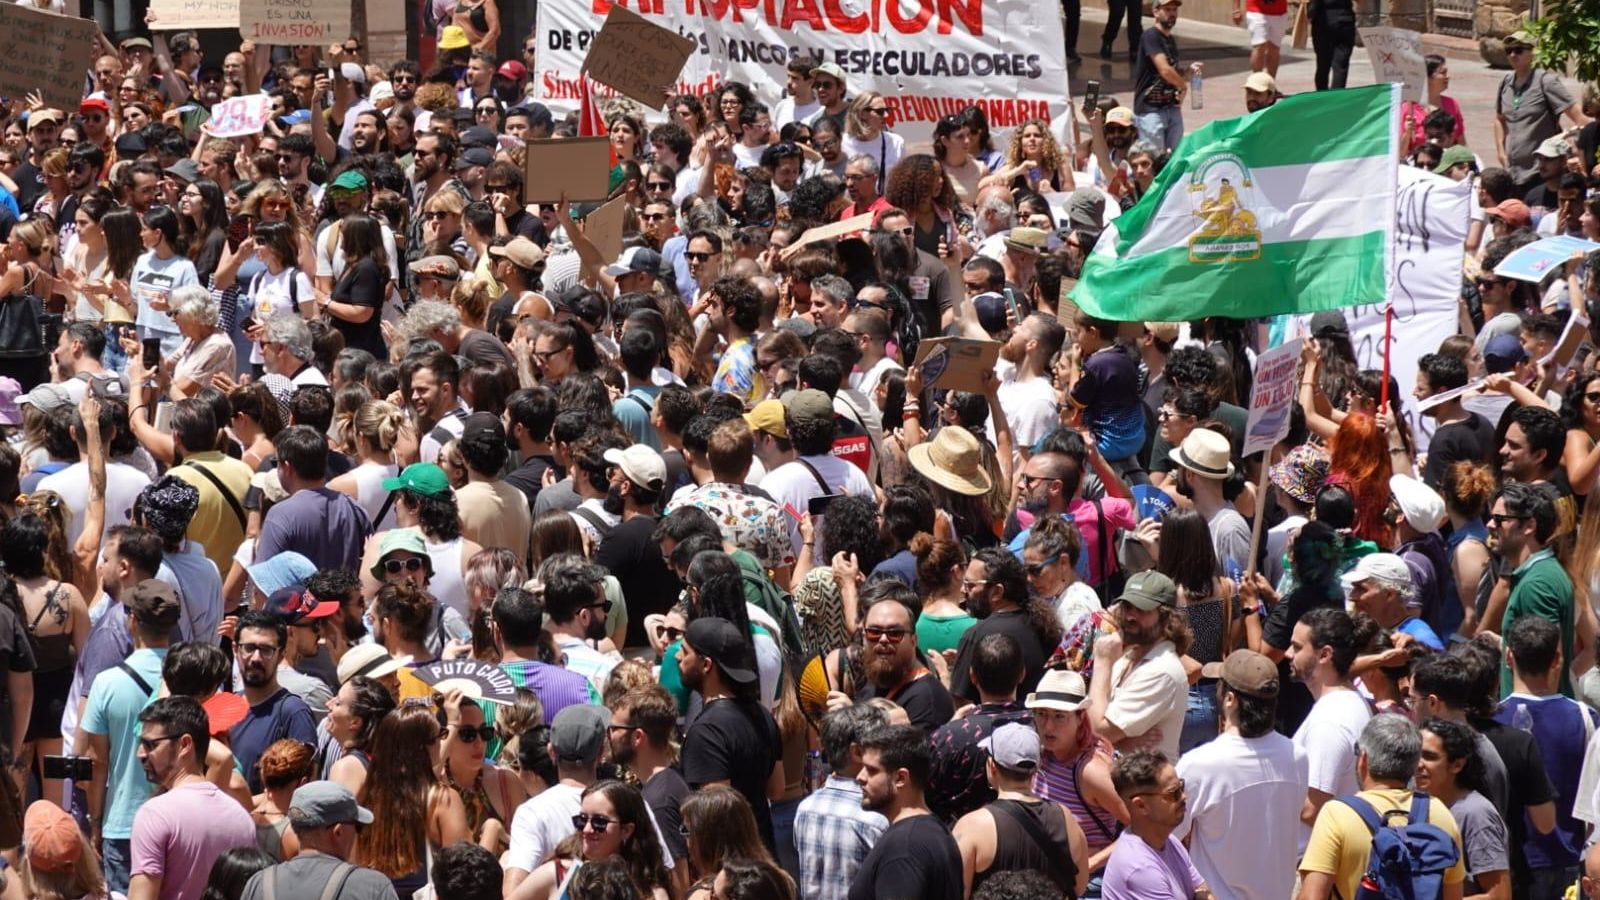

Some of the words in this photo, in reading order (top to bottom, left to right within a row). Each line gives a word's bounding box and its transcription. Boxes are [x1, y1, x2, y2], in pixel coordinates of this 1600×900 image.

[266, 9, 283, 20] ES
[288, 9, 313, 20] UNA
[548, 30, 572, 51] DE
[835, 50, 1042, 79] ESPECULADORES
[1254, 390, 1271, 409] UN
[431, 662, 477, 679] PUTO
[476, 664, 515, 695] CALOR
